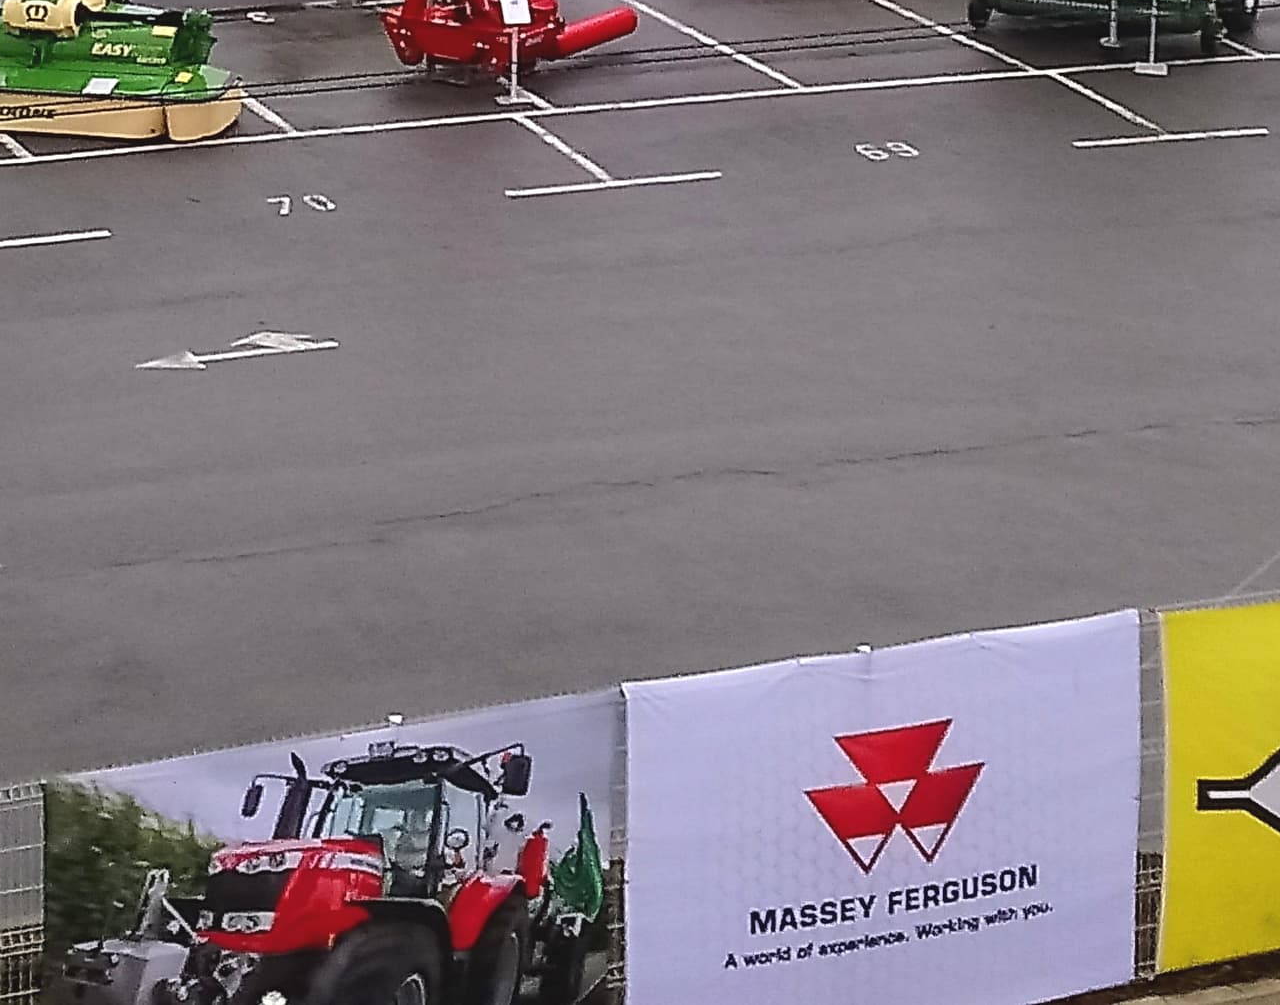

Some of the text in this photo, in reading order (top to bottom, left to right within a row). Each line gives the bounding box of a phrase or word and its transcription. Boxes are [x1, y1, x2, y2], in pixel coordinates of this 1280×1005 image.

[91, 42, 132, 57] EASY
[855, 141, 920, 161] 69
[749, 863, 1039, 935] MASSEY FERGUSON
[723, 901, 1055, 970] A world of experience. Working with you.
